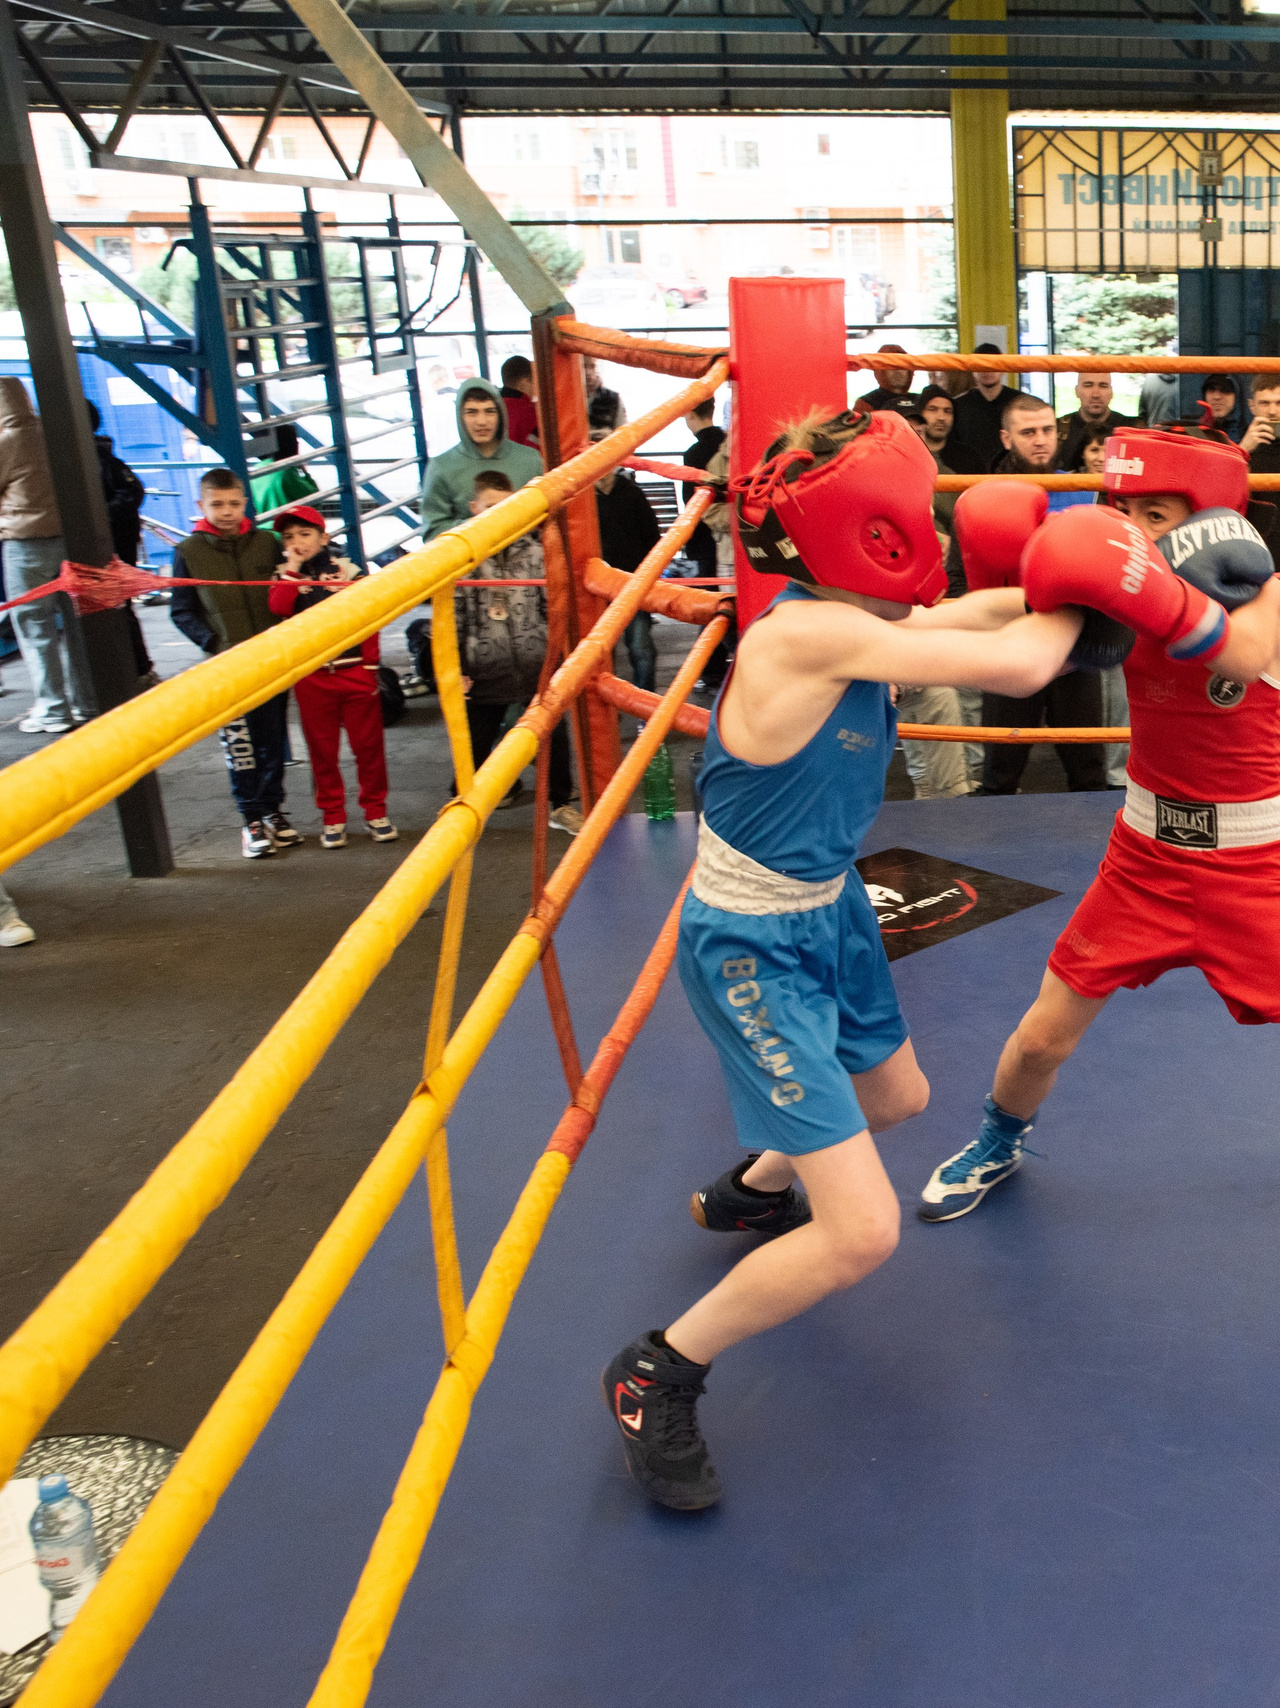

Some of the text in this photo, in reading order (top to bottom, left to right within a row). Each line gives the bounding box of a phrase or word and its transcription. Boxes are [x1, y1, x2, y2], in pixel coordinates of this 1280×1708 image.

[1159, 802, 1210, 834] EVERLAST
[896, 887, 962, 914] FIGHT
[722, 957, 805, 1107] BOXING
